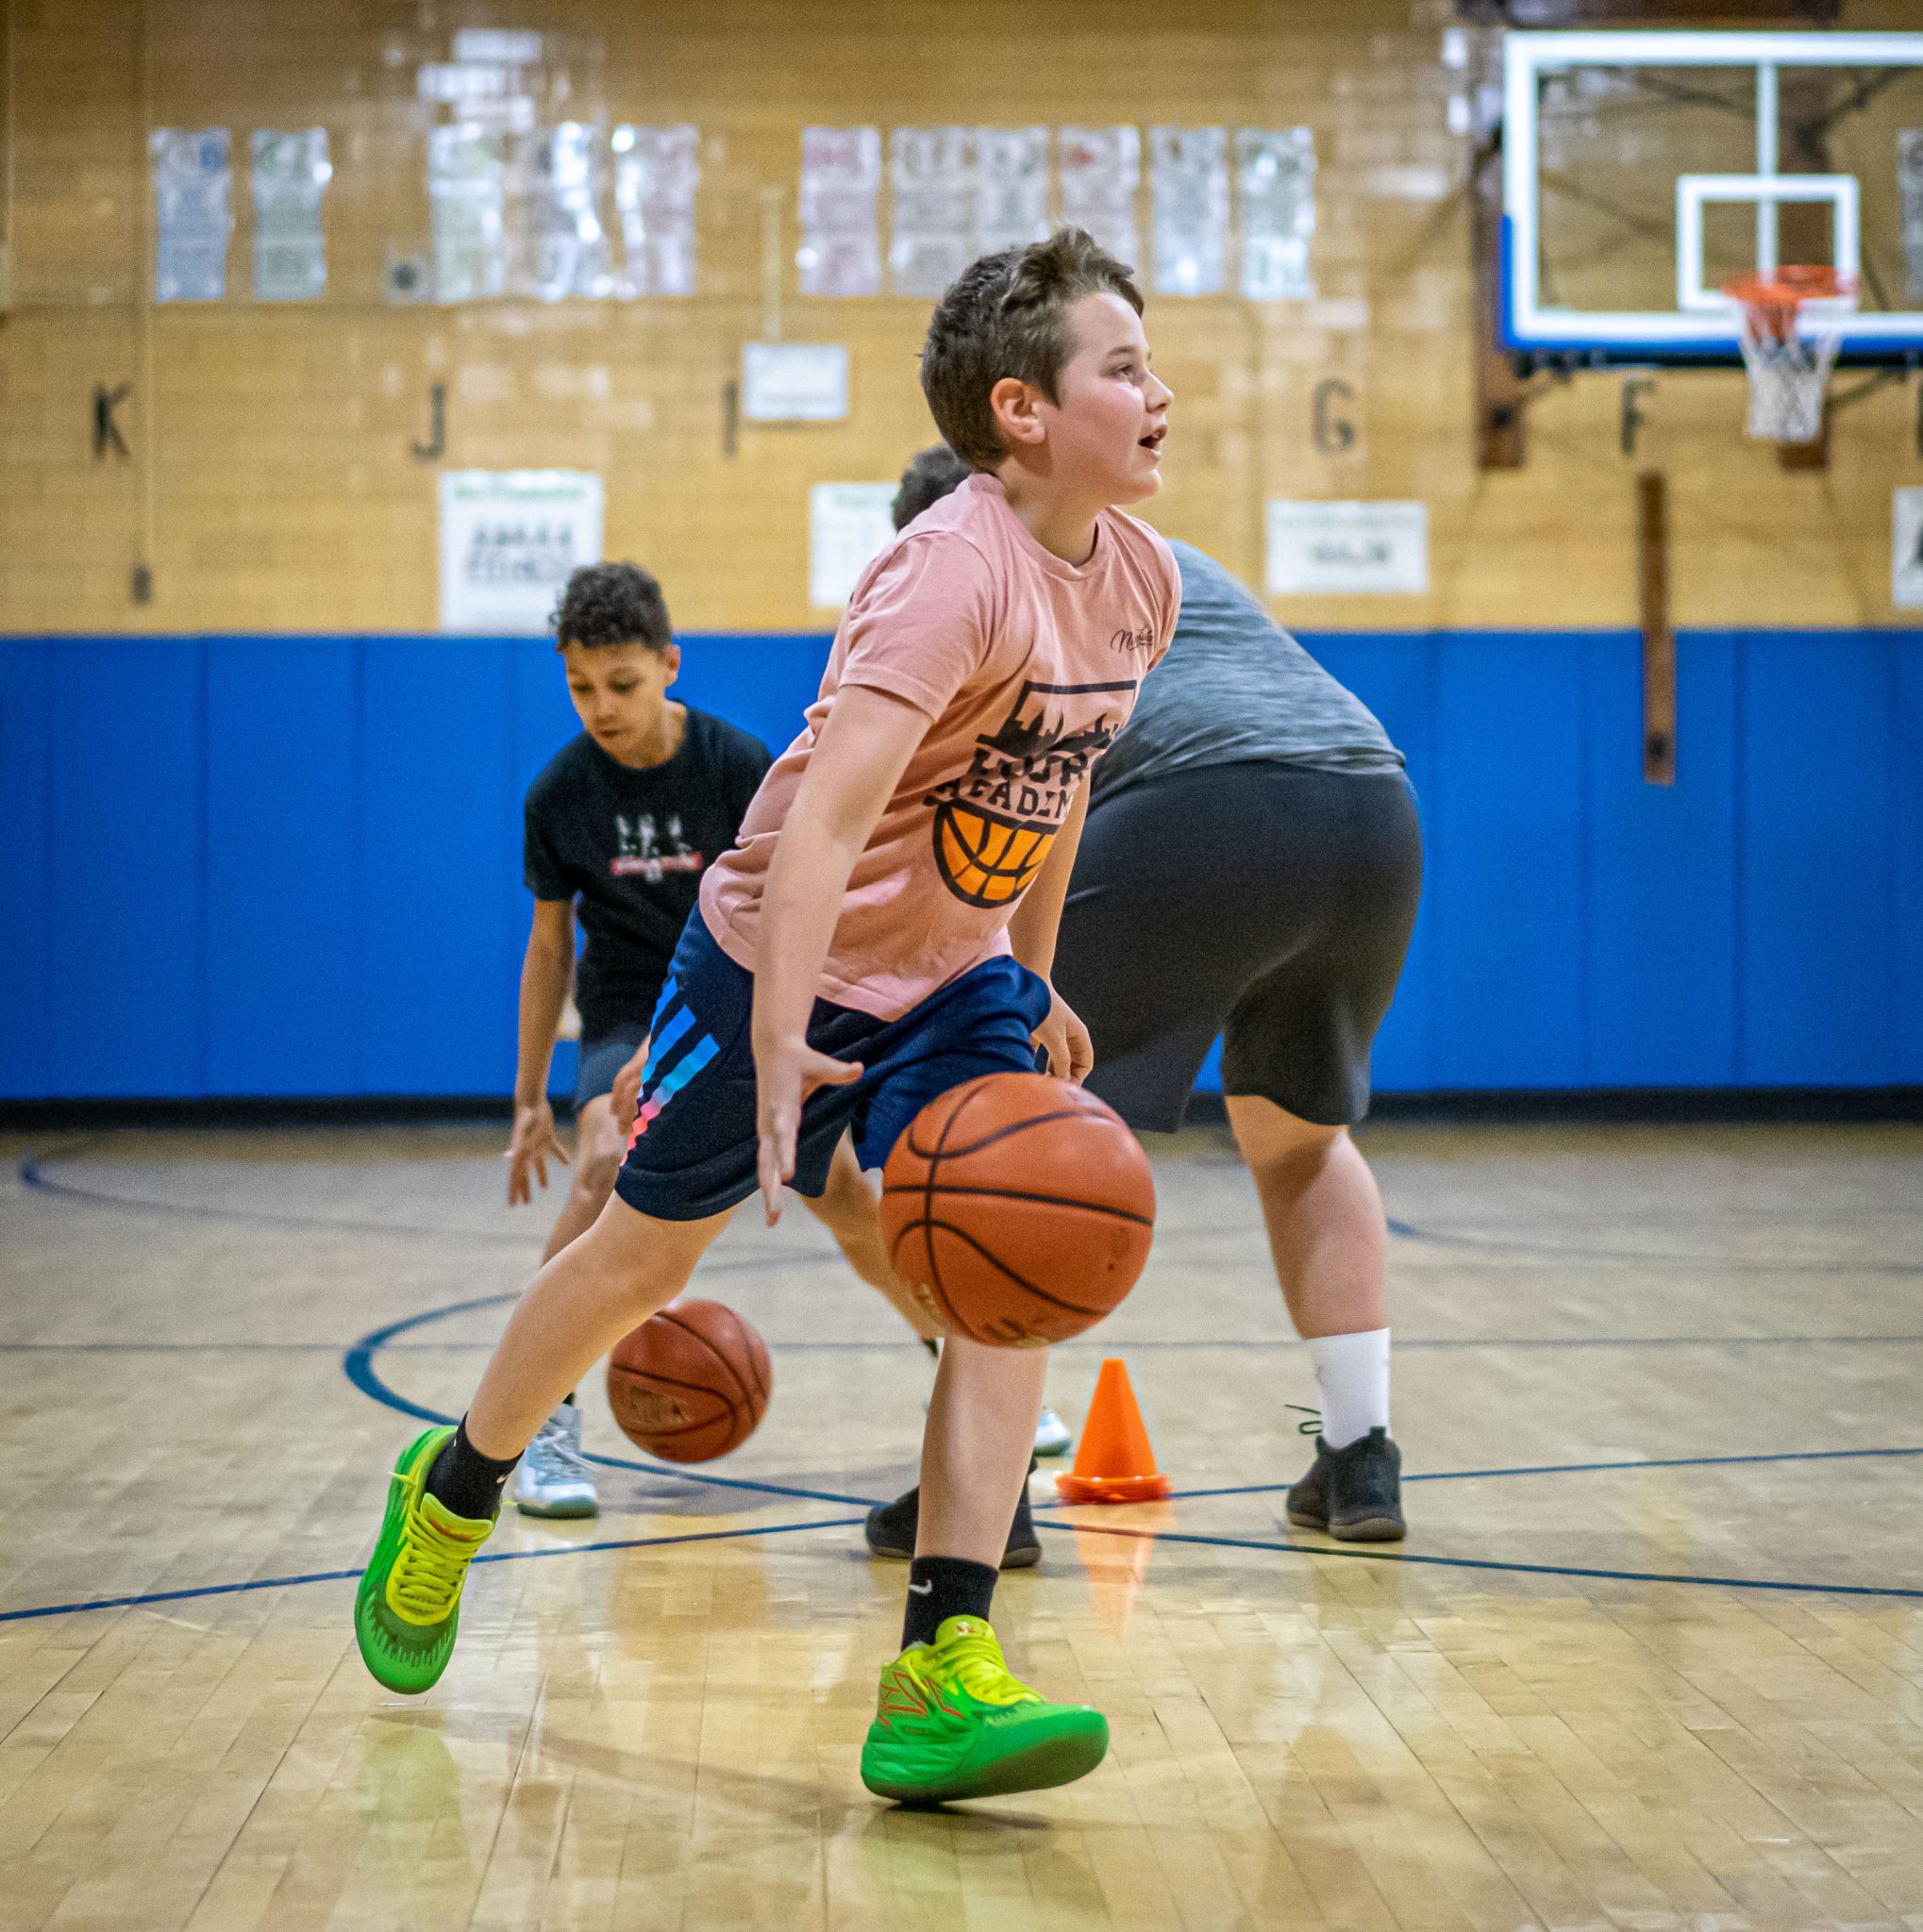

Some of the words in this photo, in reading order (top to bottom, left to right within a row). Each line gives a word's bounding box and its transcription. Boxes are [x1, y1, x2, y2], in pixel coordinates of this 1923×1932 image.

[92, 381, 132, 461] K
[410, 382, 445, 462] J
[1313, 379, 1354, 457] G
[1622, 378, 1658, 457] F
